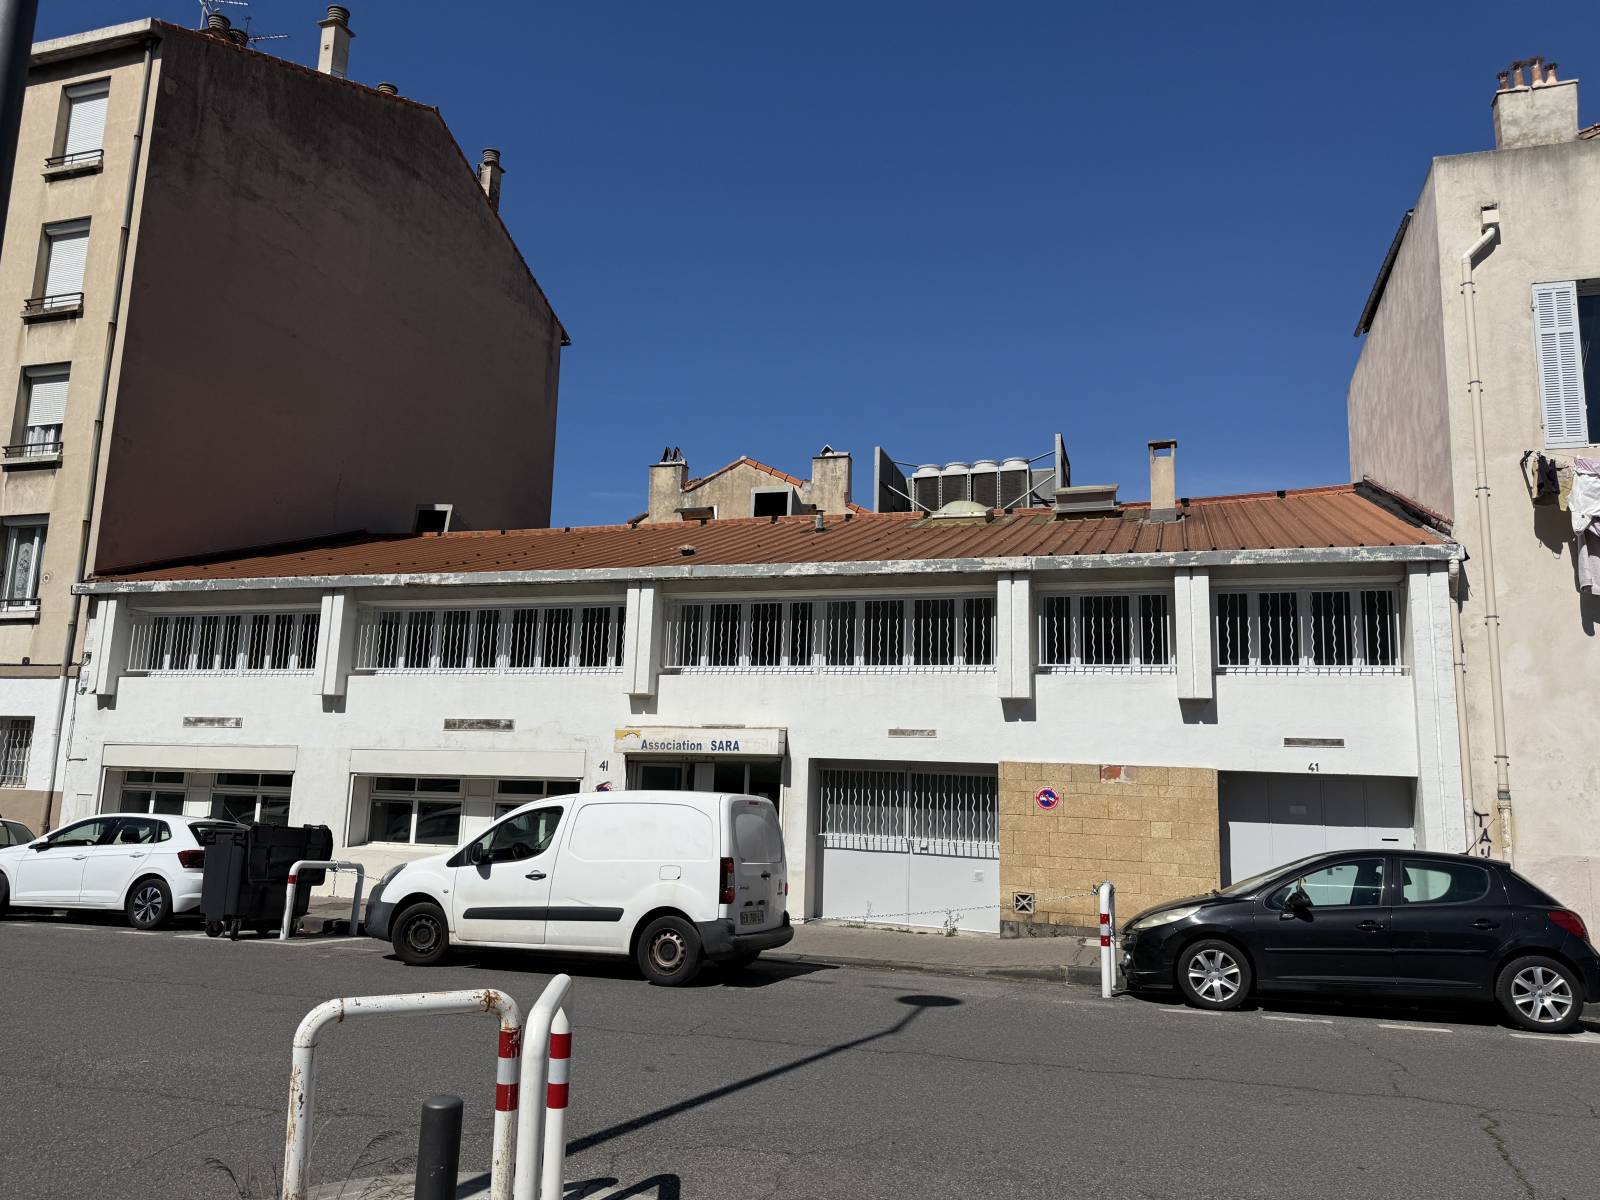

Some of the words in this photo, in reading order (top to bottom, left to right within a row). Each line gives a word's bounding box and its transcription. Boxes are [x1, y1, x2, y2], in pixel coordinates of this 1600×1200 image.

[641, 739, 703, 751] Association
[710, 740, 740, 752] SARA
[599, 760, 609, 772] 41
[1308, 762, 1319, 772] 41
